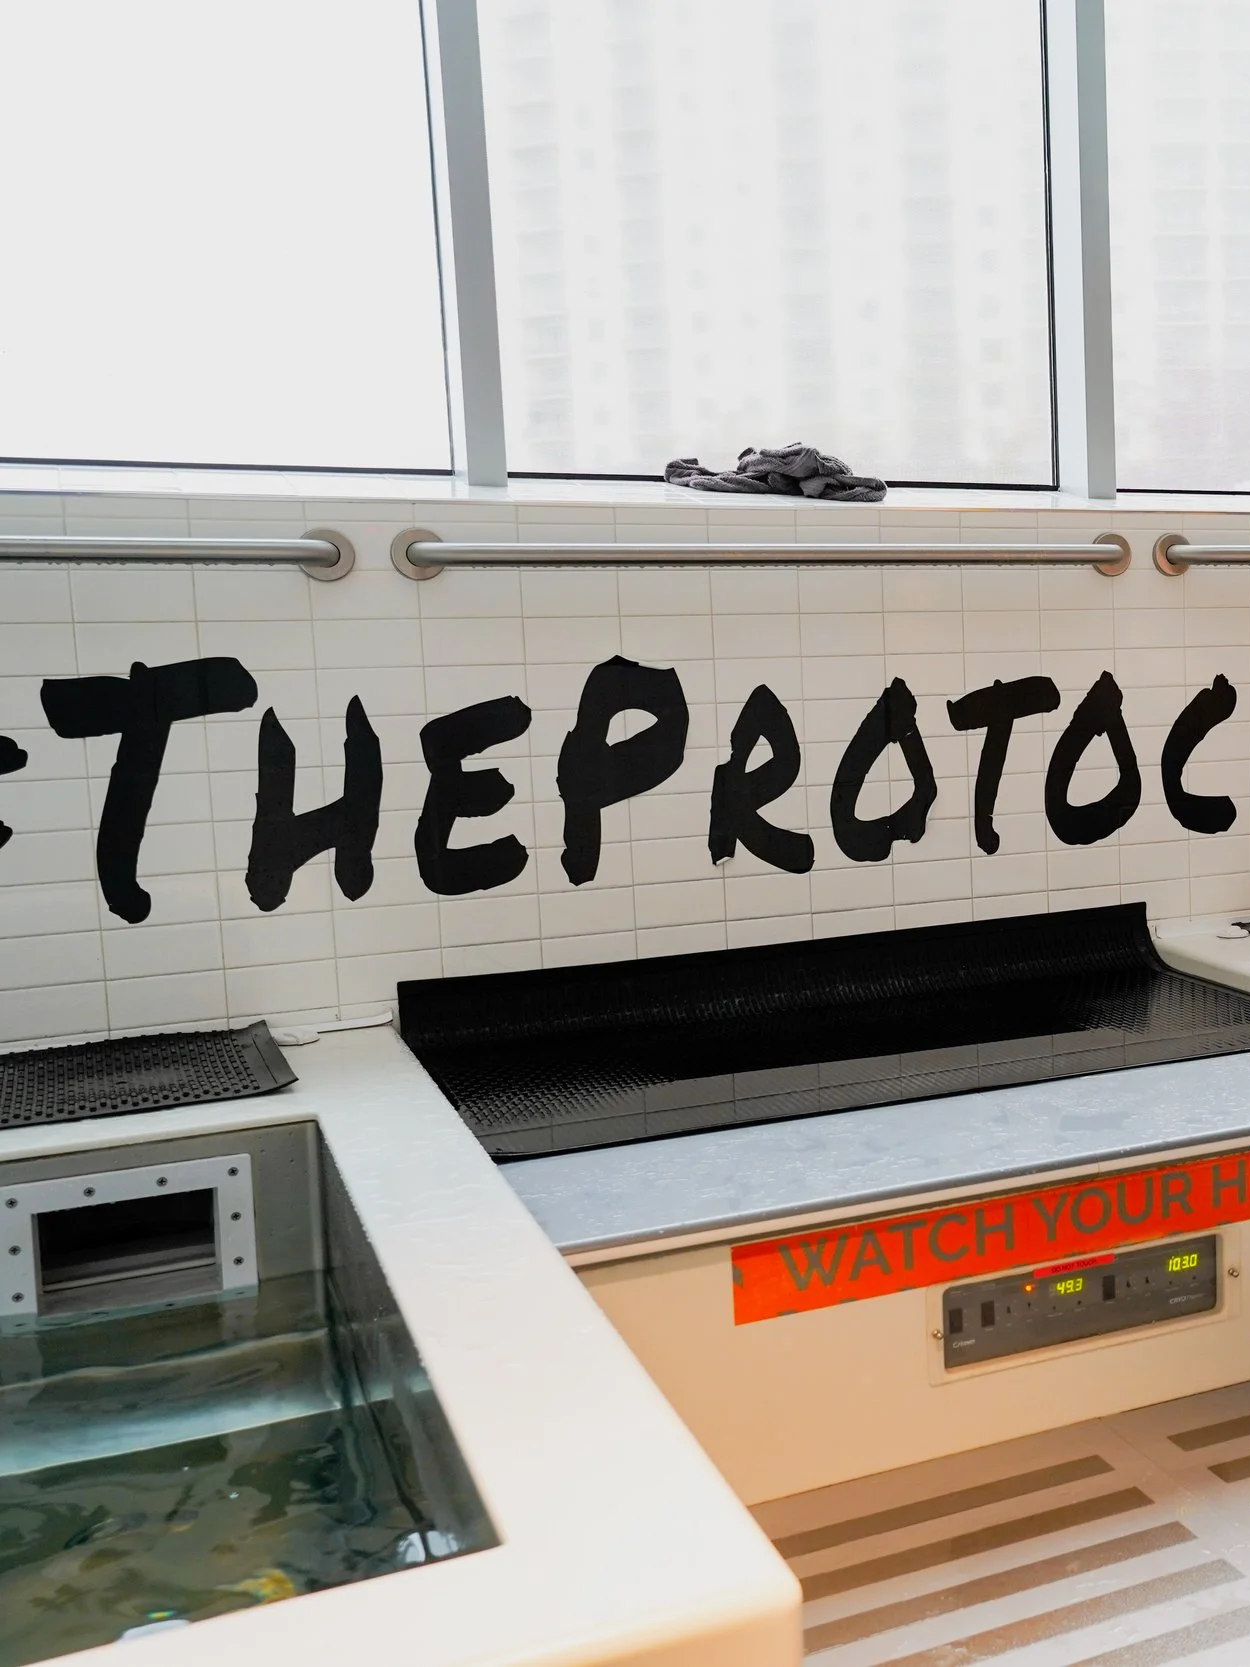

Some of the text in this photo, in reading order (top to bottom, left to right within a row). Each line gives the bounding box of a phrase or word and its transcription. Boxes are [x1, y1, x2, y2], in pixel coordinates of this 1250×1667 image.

[777, 1203, 1015, 1291] WATCH
[1033, 1171, 1193, 1242] YOUR
[1051, 1265, 1060, 1274] DO
[1061, 1262, 1074, 1271] NOT
